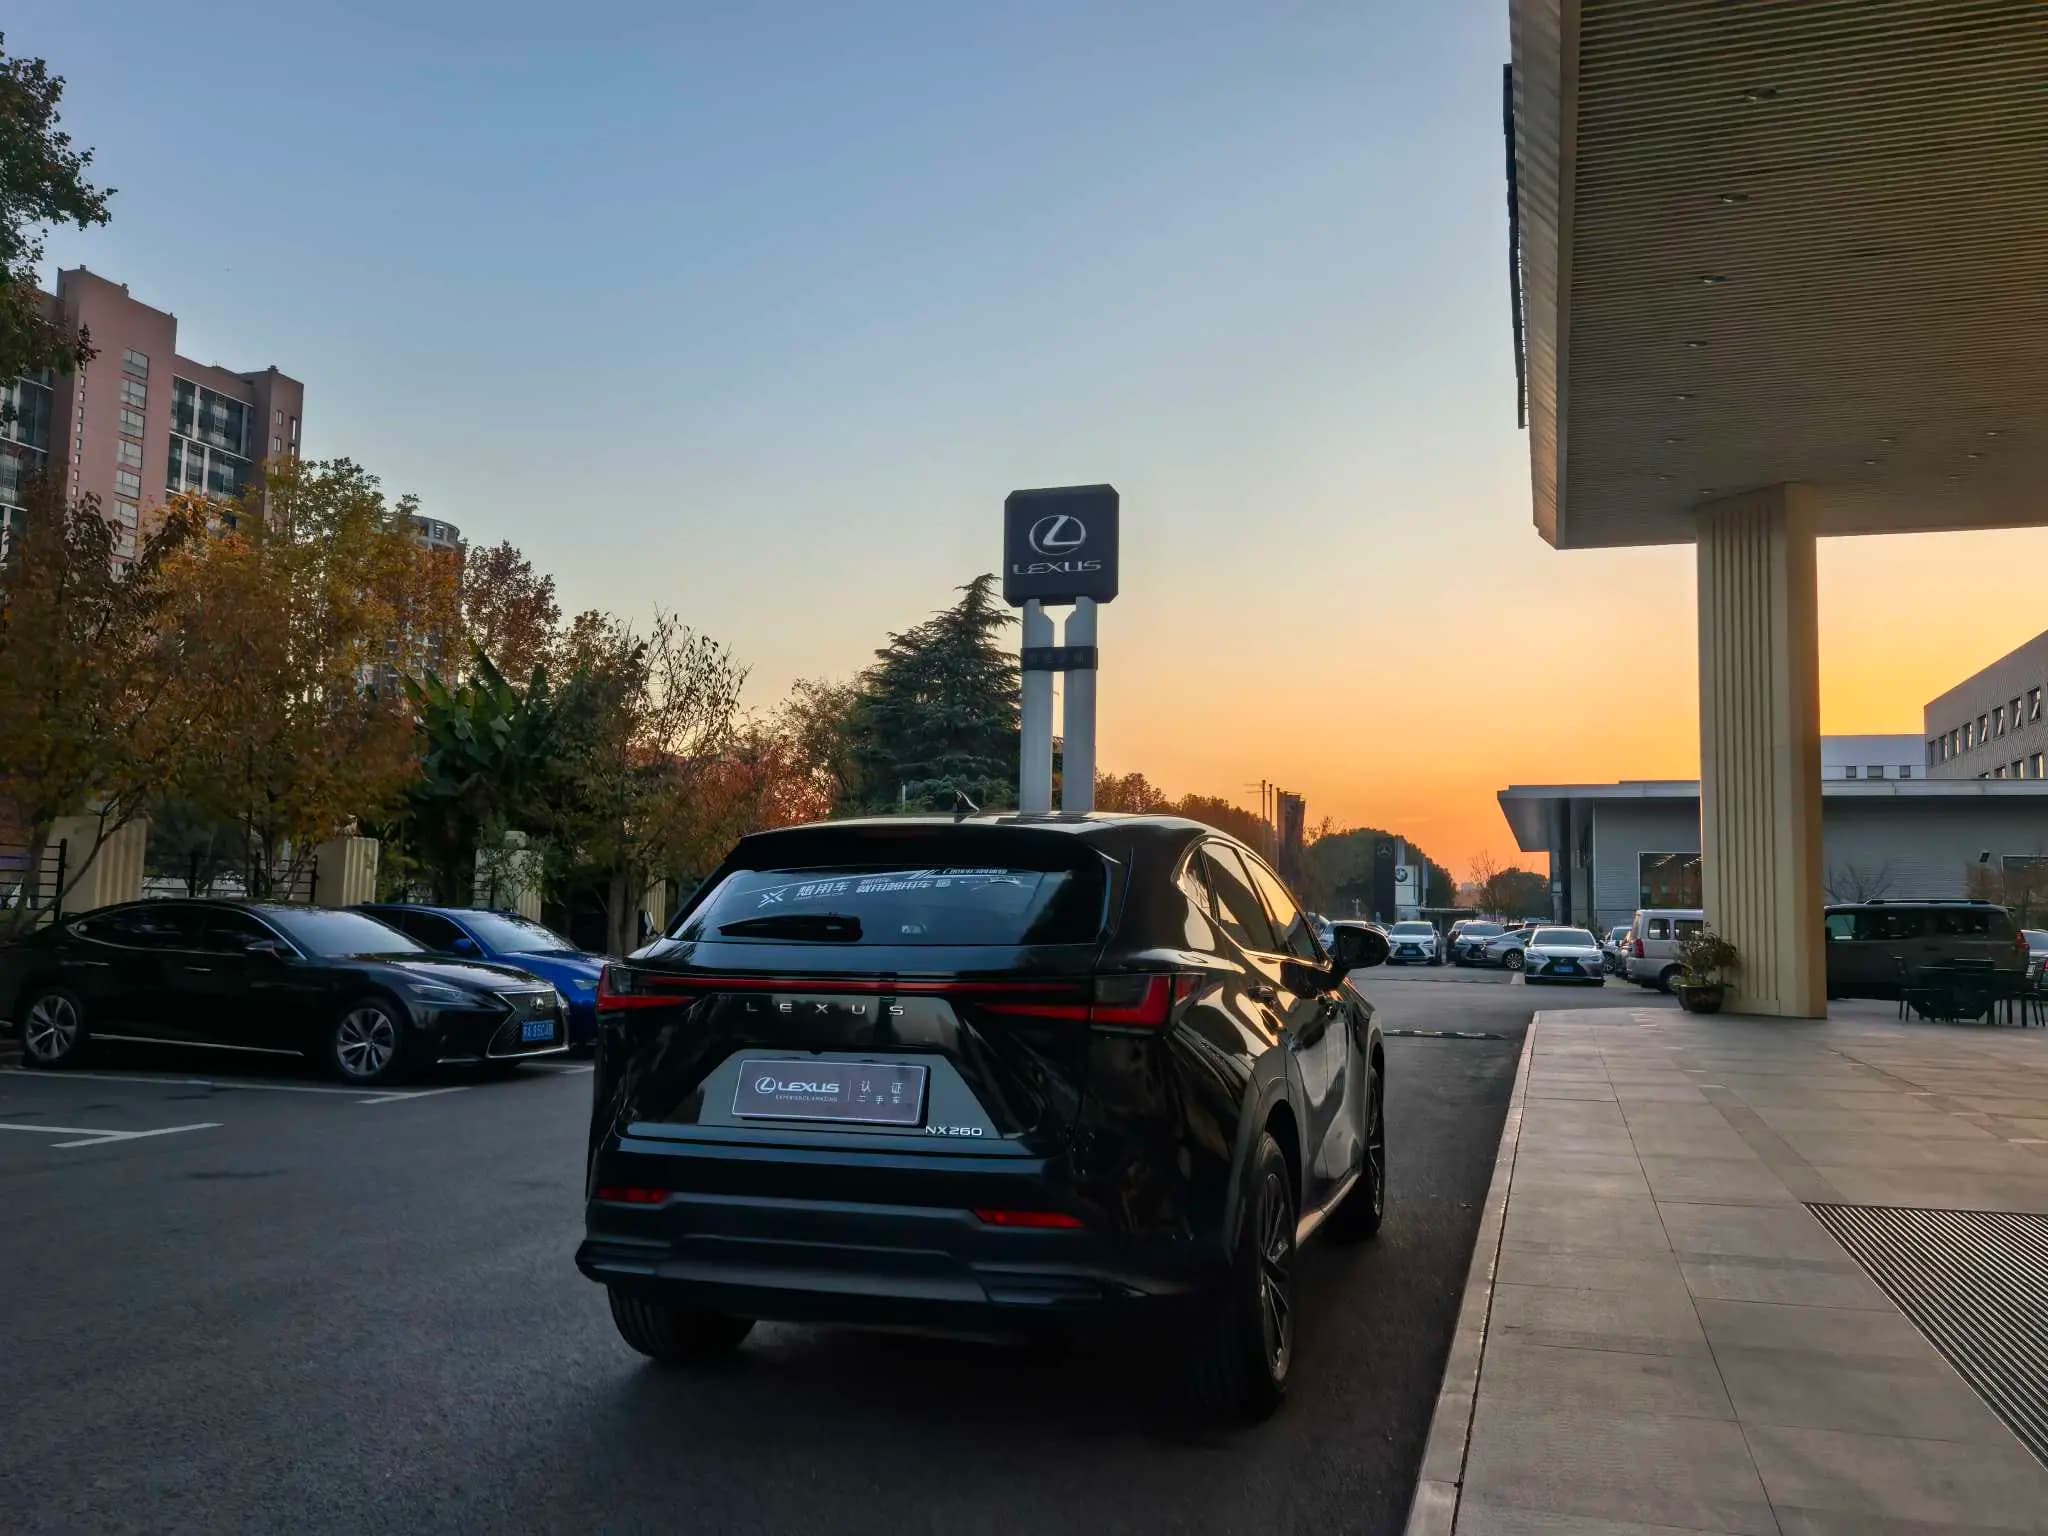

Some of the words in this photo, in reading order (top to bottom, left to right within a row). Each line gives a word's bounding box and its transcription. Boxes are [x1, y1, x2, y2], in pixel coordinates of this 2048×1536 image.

[1012, 559, 1102, 575] LEXUS
[746, 1001, 904, 1016] LEXUS
[777, 1081, 840, 1093] LEXUS
[925, 1125, 983, 1137] NX260
